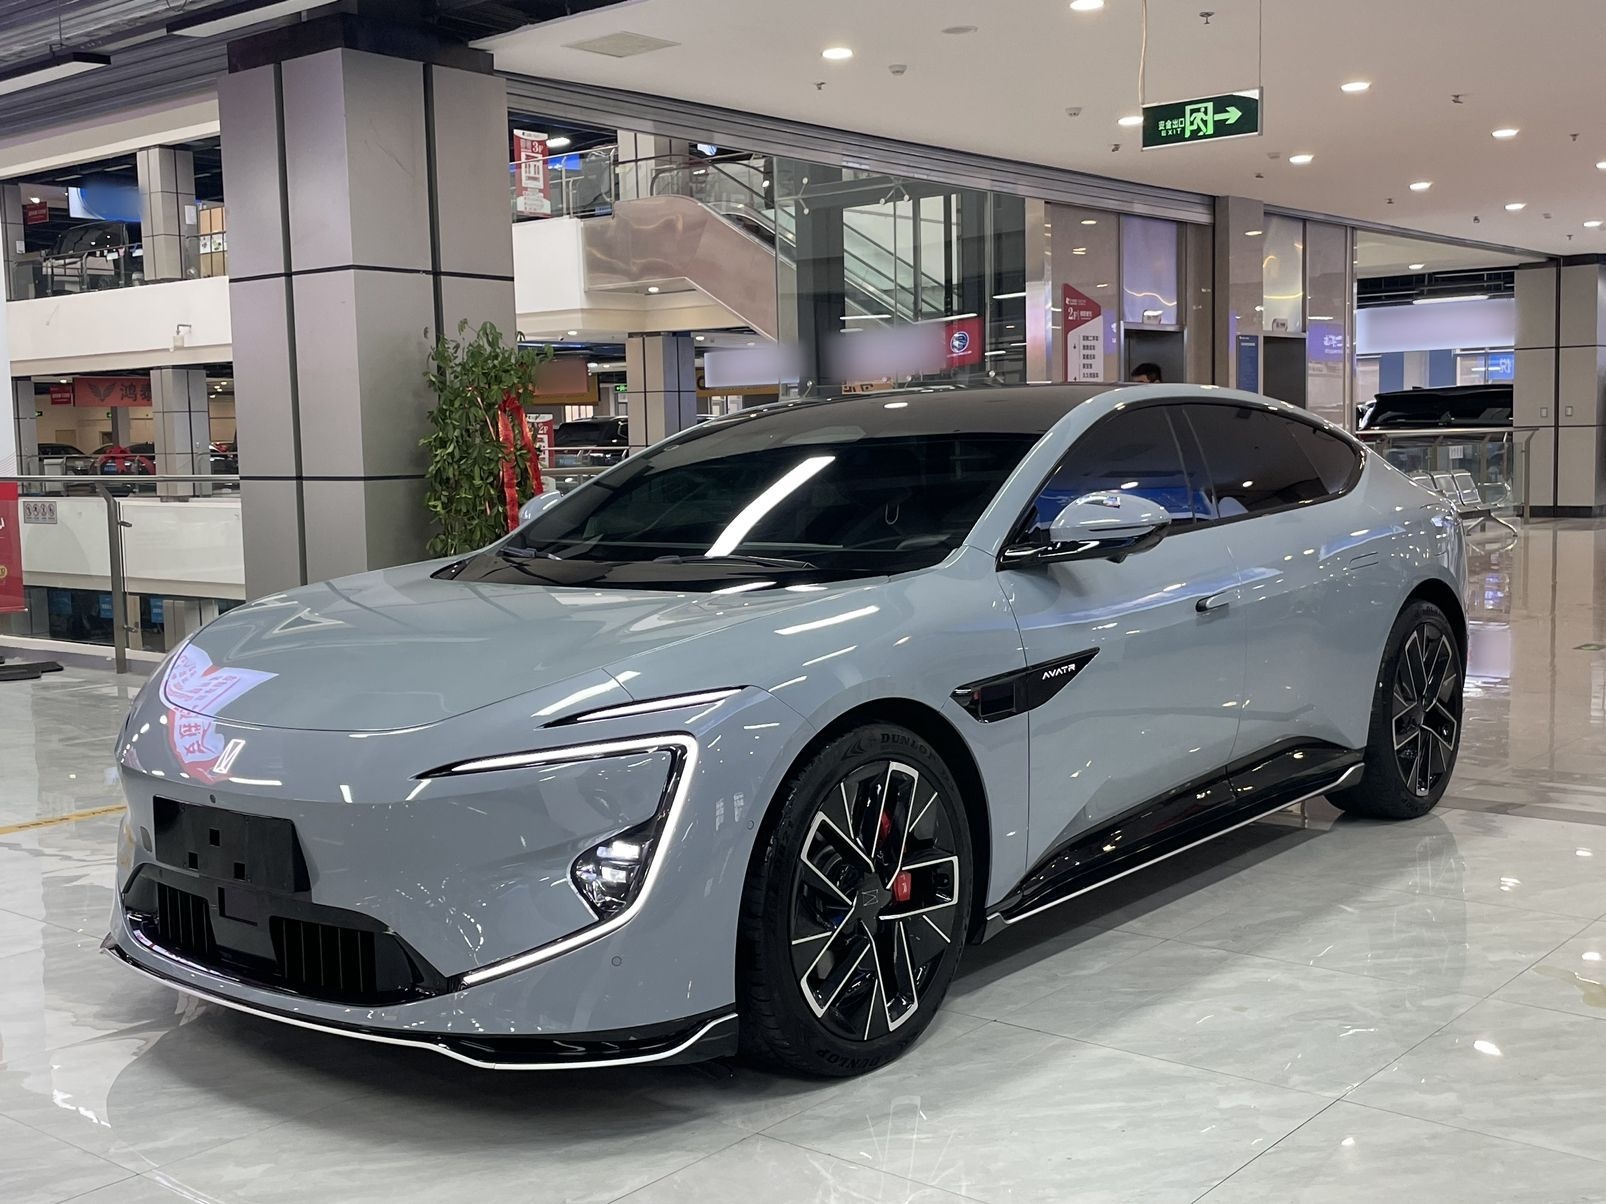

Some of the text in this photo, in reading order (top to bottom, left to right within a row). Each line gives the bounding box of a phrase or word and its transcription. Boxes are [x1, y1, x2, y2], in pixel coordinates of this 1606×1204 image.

[1158, 118, 1184, 130] 安全出口
[1161, 128, 1181, 136] EXIT
[1042, 663, 1075, 680] AVATR
[880, 733, 937, 760] DUNLOP
